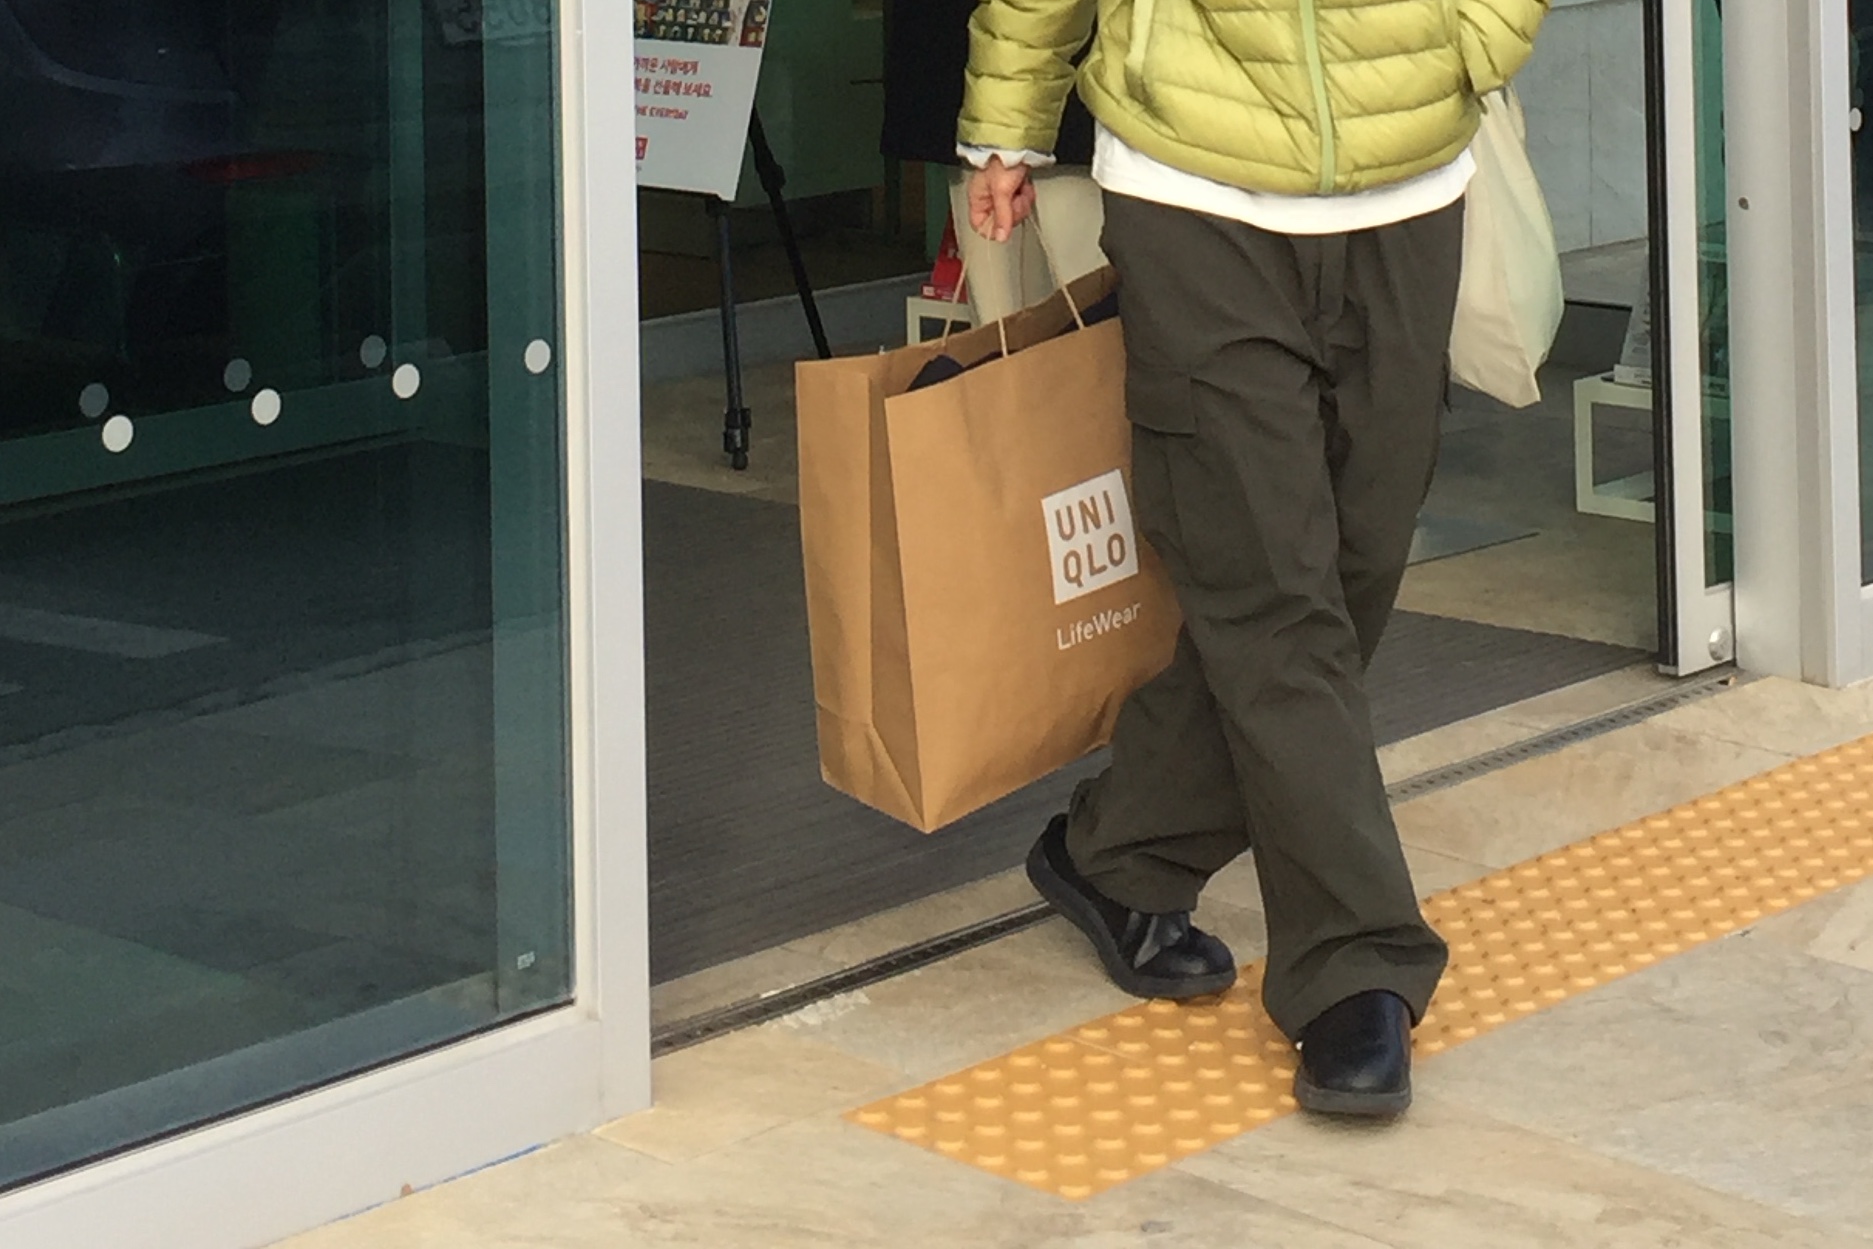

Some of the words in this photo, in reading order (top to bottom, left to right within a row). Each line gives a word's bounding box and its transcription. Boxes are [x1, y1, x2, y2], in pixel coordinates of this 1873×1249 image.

[1055, 490, 1115, 541] UNI
[1063, 533, 1126, 588] QLO
[1056, 602, 1142, 651] LifeWear
